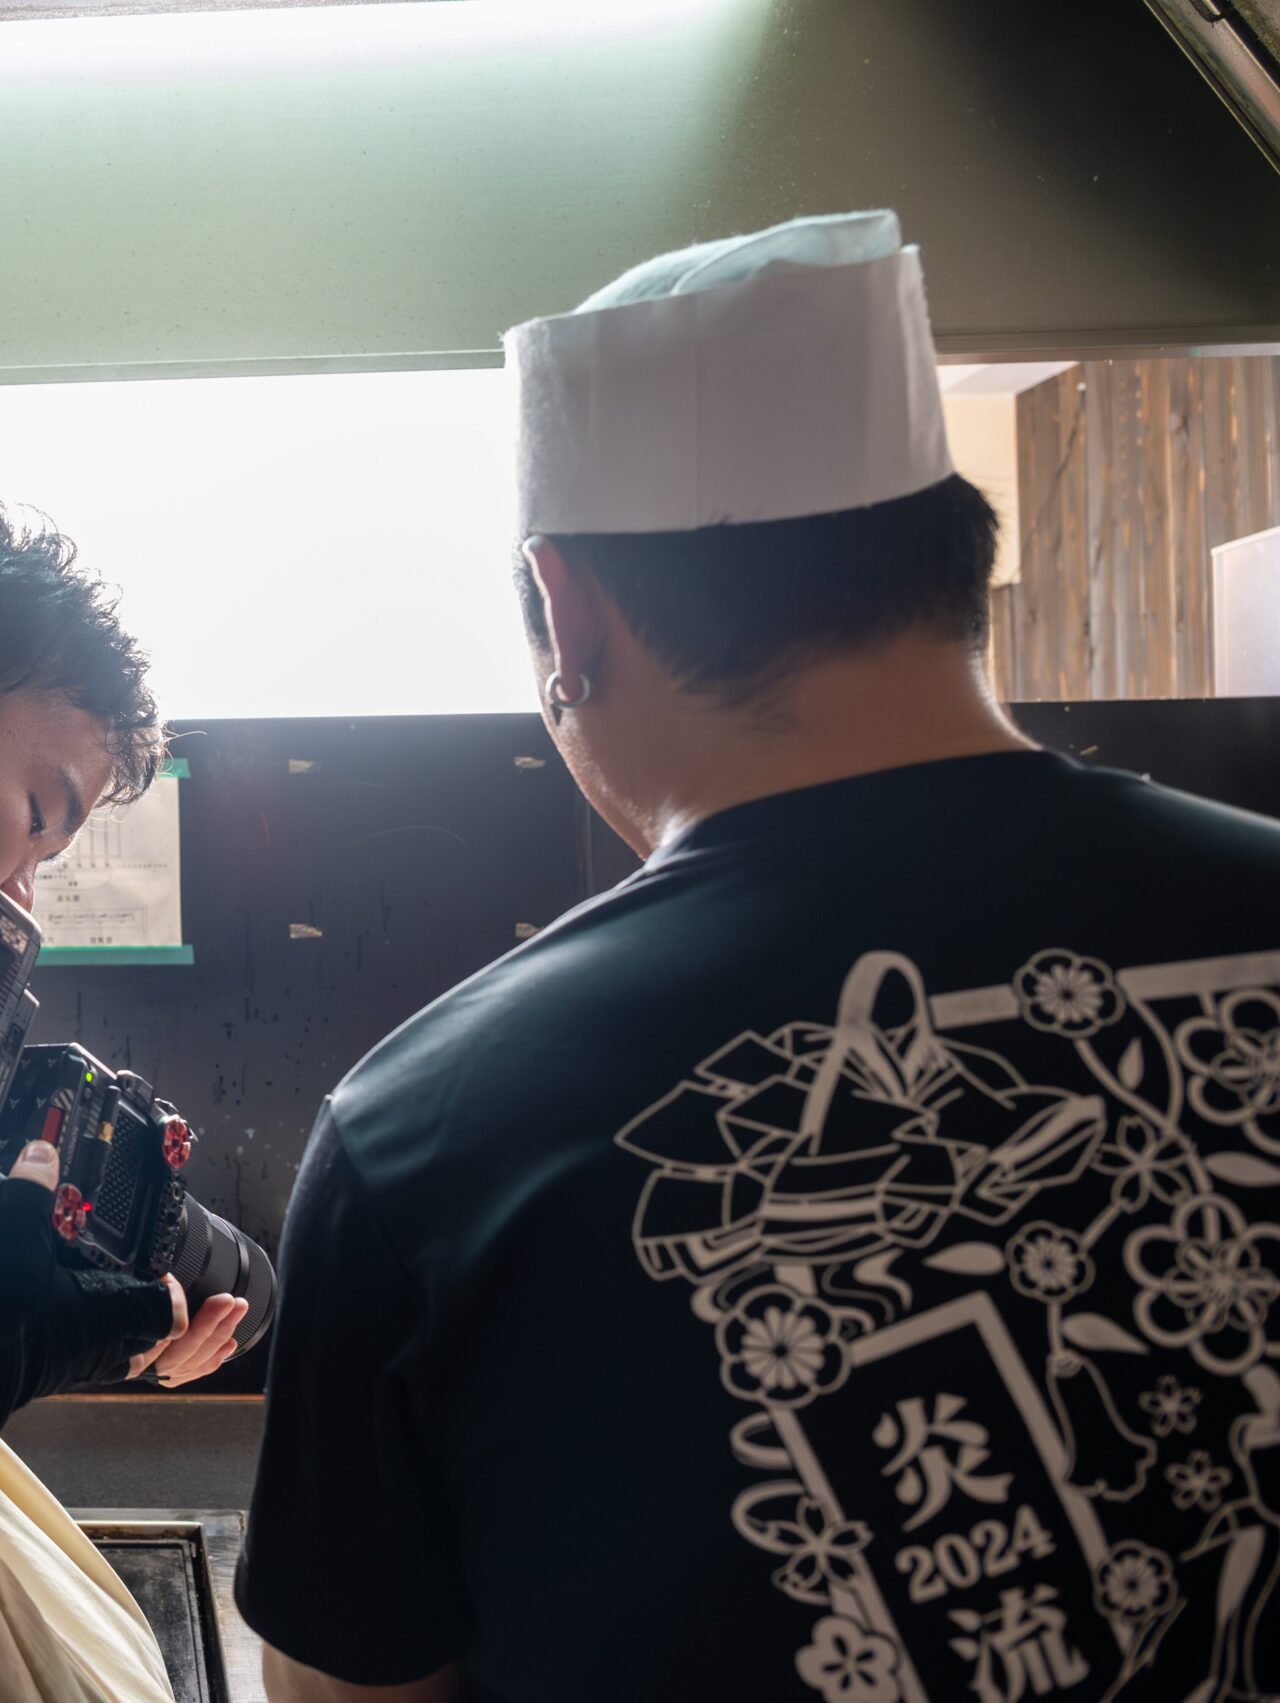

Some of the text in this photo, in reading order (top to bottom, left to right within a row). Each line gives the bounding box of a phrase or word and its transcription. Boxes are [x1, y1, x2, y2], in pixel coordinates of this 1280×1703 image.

[872, 1393, 1015, 1533] 炎
[895, 1504, 1057, 1604] 2024
[948, 1584, 1090, 1703] 流
